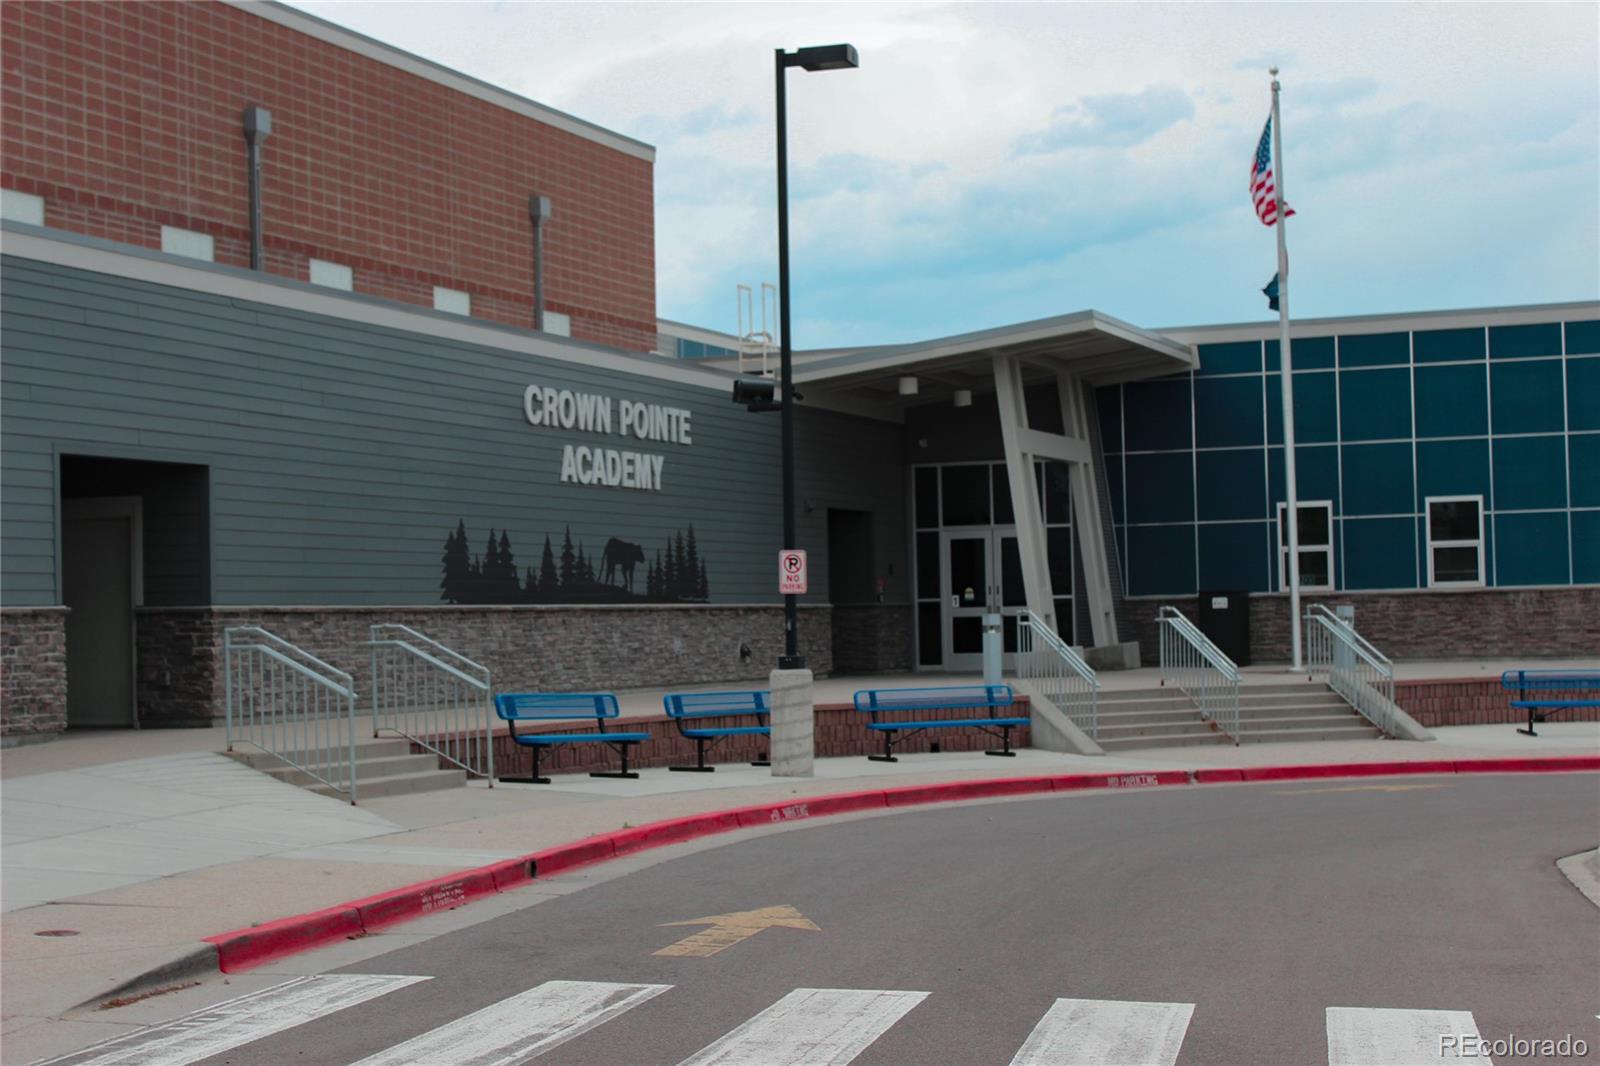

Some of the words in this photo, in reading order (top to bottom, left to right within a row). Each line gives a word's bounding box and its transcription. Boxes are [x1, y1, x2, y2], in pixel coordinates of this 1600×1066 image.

[524, 384, 611, 434] CROWN
[619, 399, 692, 445] POINTE
[560, 444, 665, 490] ACADEMY
[1120, 775, 1158, 787] PARKING
